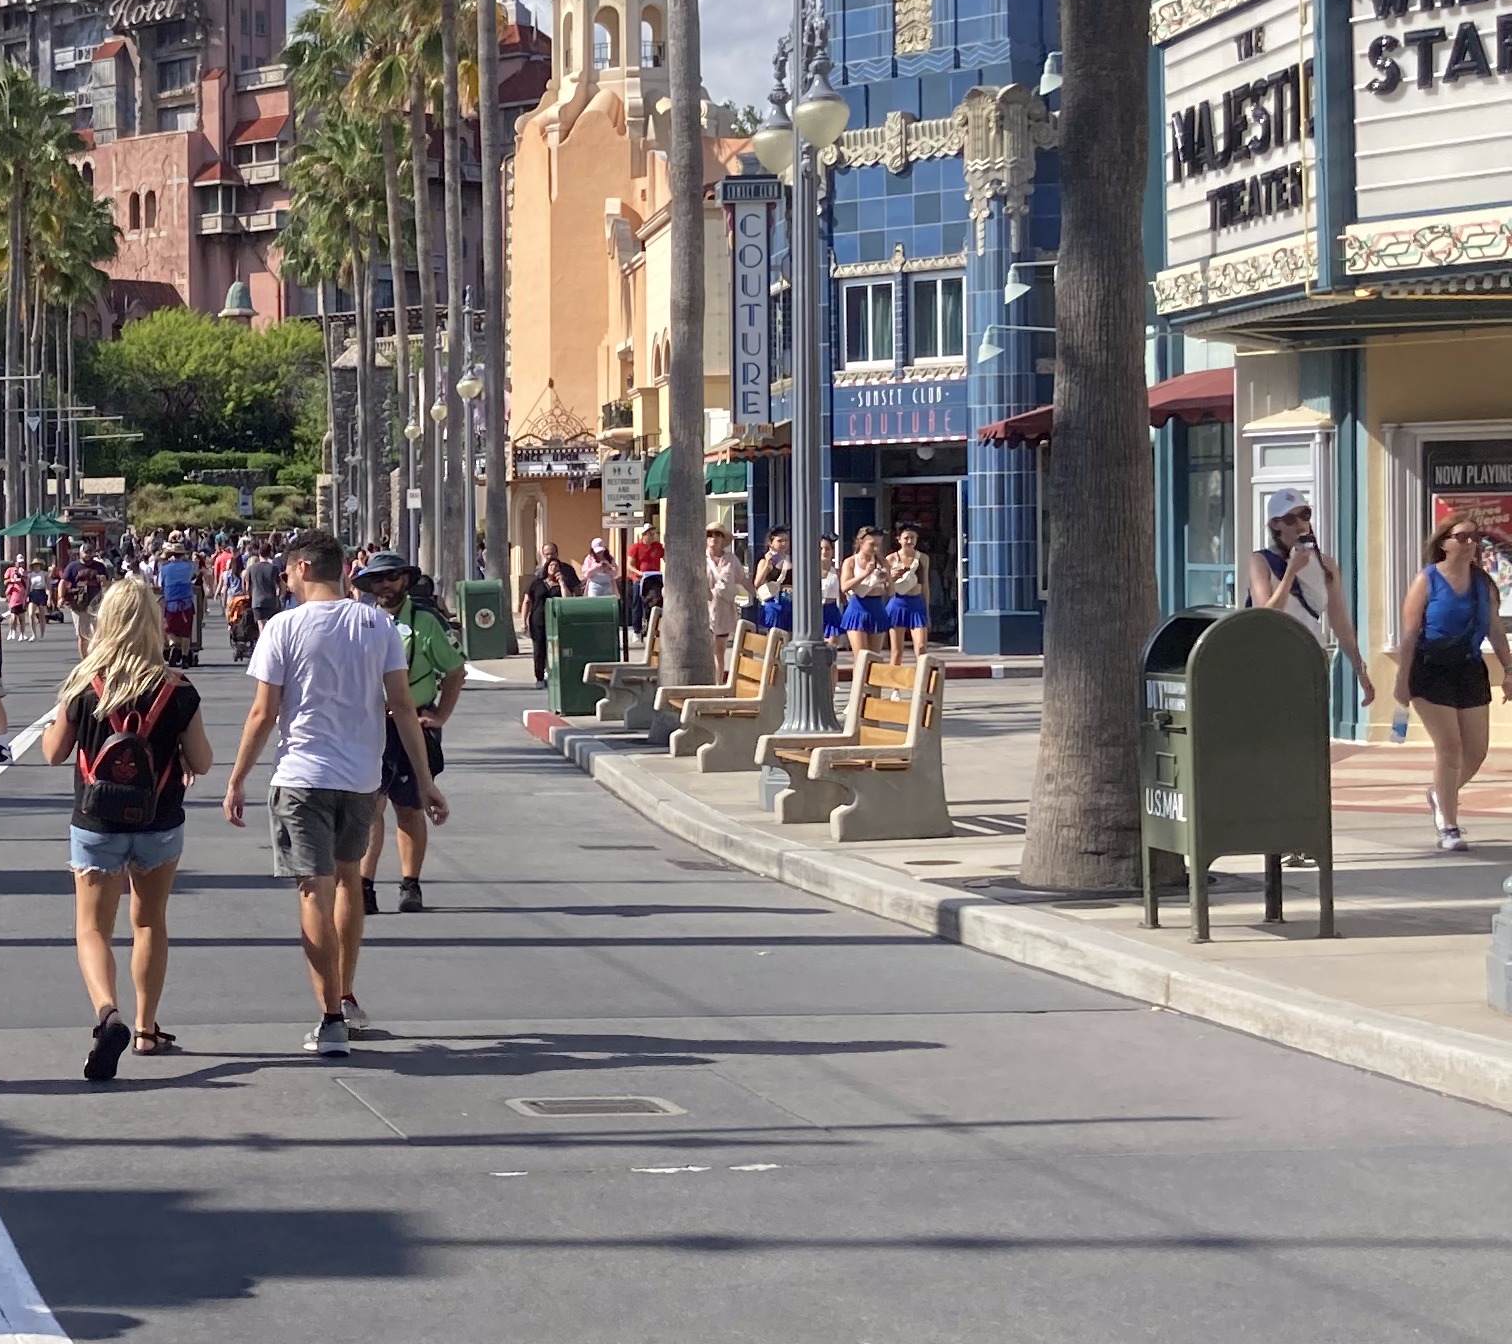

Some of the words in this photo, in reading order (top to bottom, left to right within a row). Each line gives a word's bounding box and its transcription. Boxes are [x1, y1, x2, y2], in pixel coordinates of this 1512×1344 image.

[1234, 26, 1265, 62] THE
[738, 213, 763, 415] COUTURE
[857, 388, 902, 407] SUNSET
[912, 386, 942, 404] CLUB
[849, 409, 951, 437] COUTURE
[1434, 465, 1464, 485] NOW
